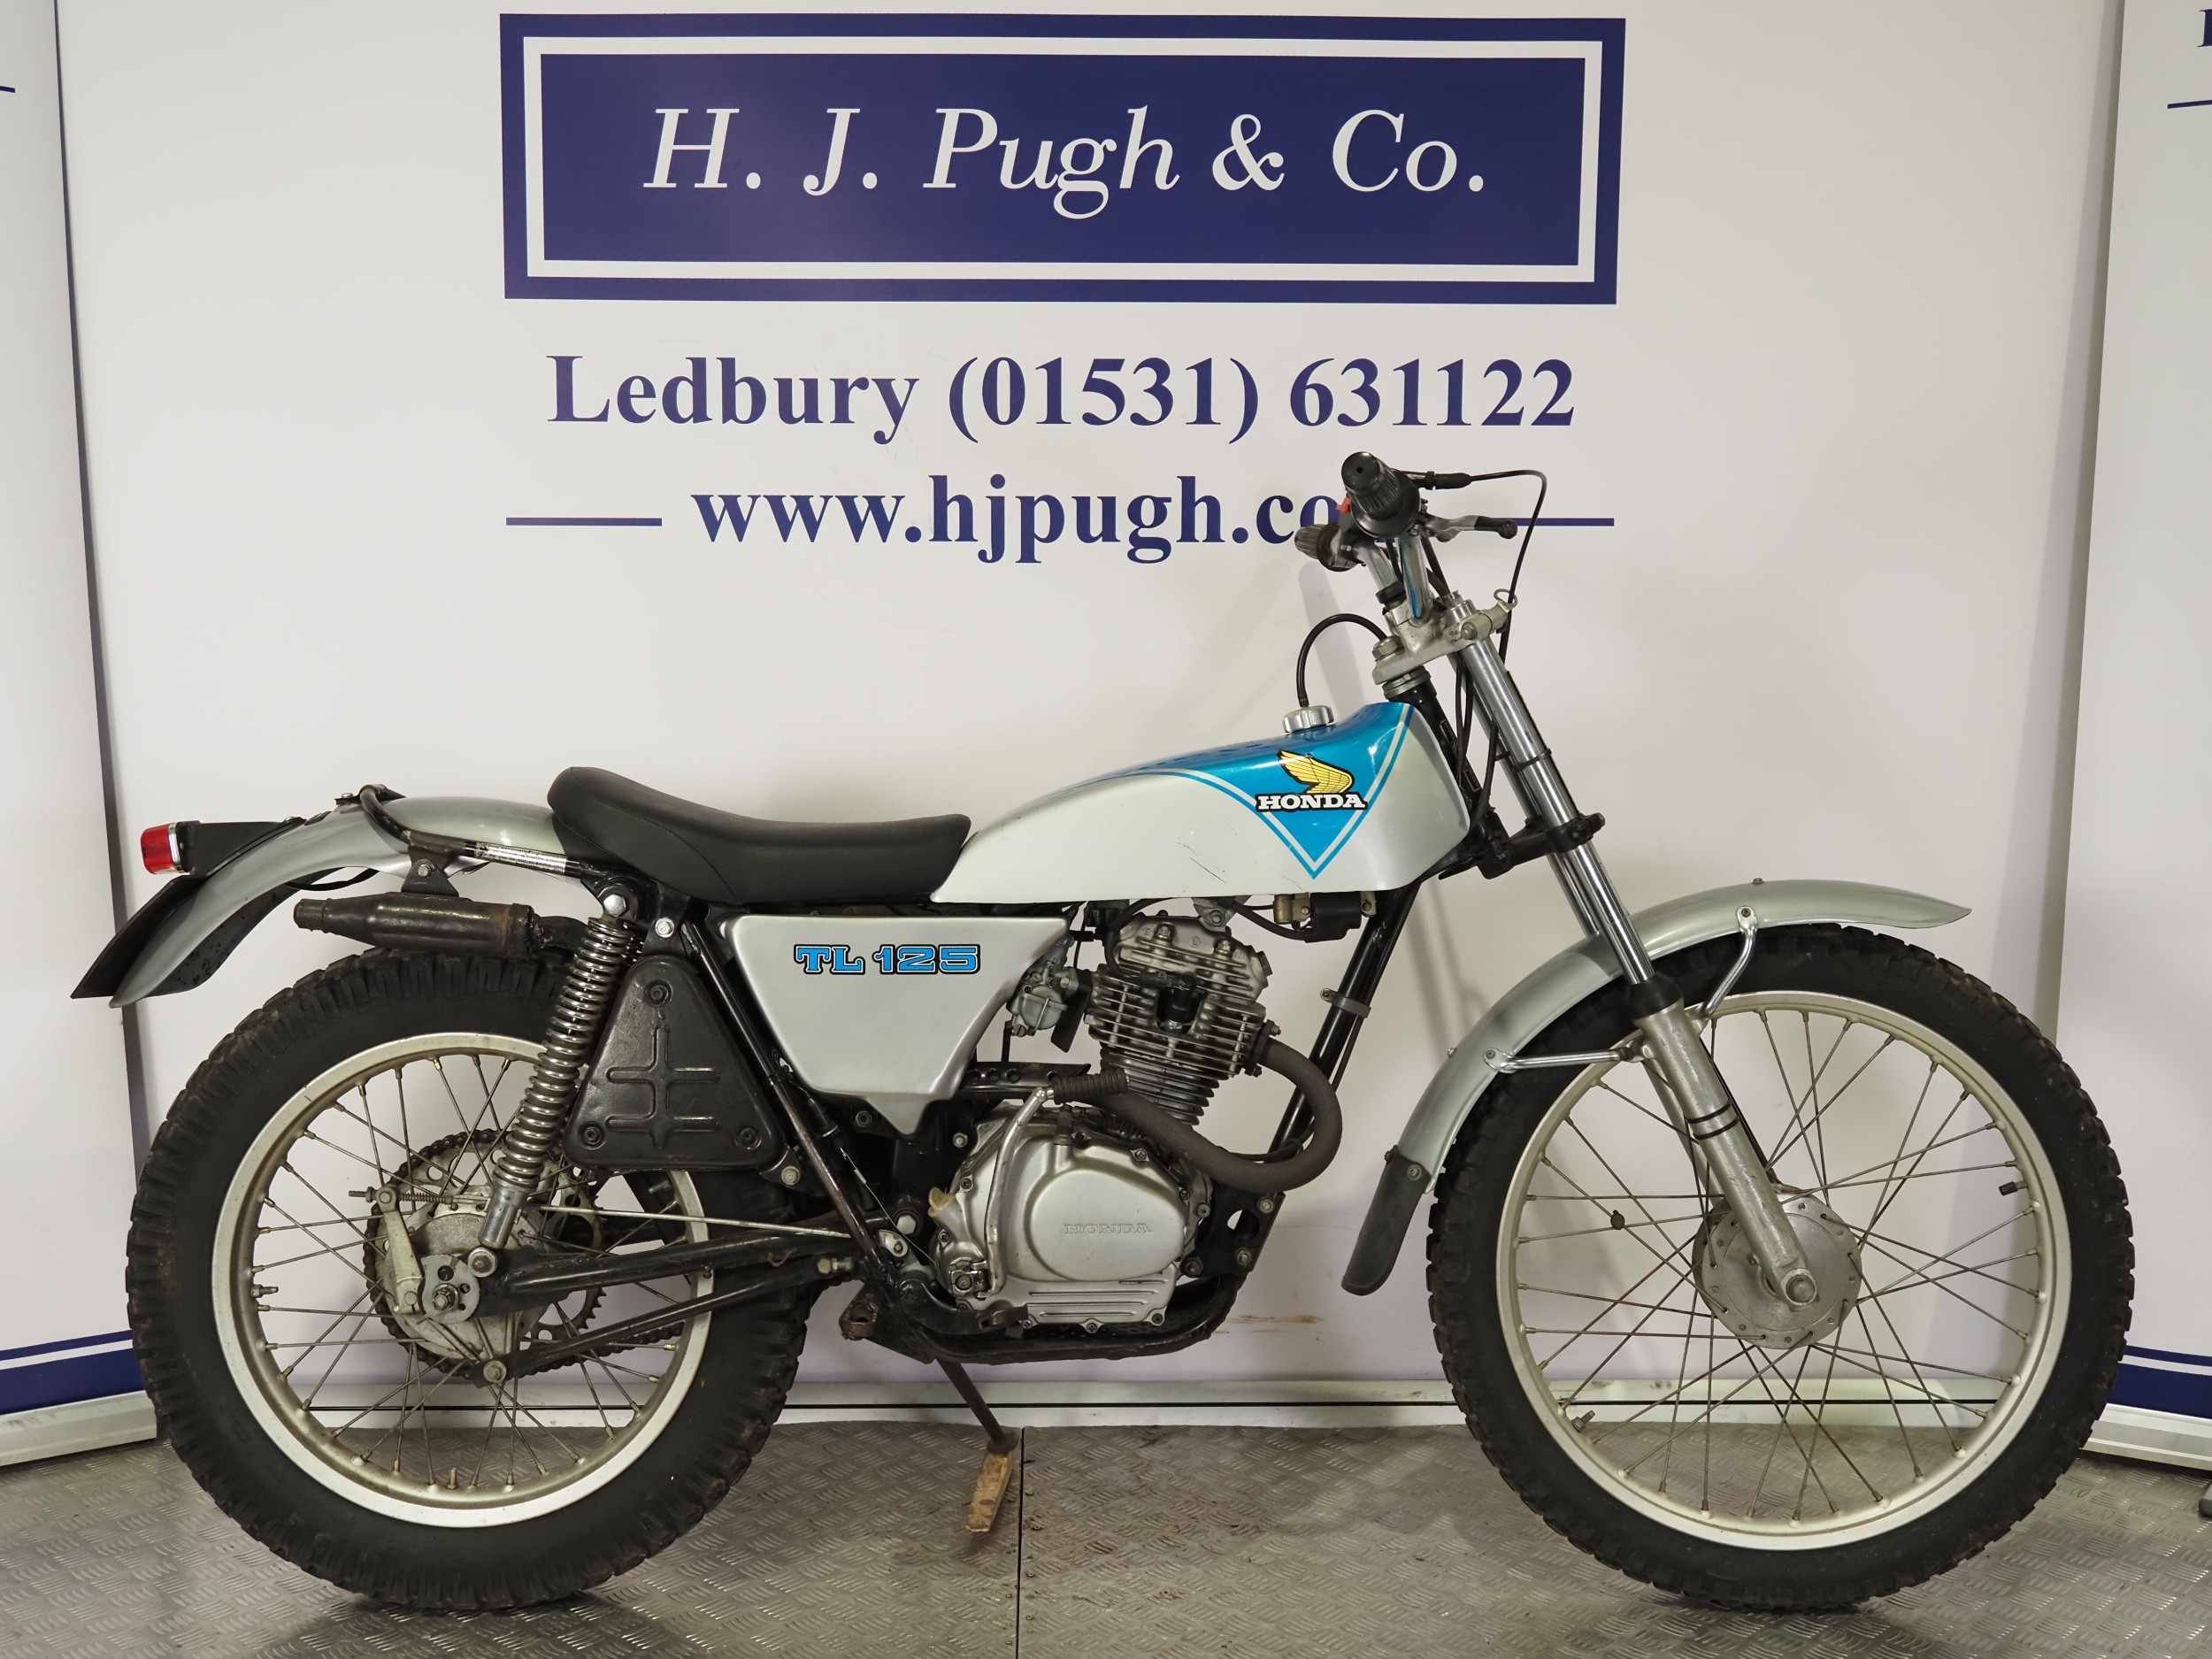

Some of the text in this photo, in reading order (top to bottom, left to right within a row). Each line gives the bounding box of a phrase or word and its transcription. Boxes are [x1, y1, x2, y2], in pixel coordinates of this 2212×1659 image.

[643, 104, 1485, 219] H. J. Pugh & Co.
[546, 355, 1575, 445] Ledbury (01531) 631122
[690, 473, 1396, 565] www.hjpugh.co
[1257, 793, 1366, 810] HONDA
[795, 944, 980, 974] TL 125
[1064, 1223, 1153, 1235] HONDA
